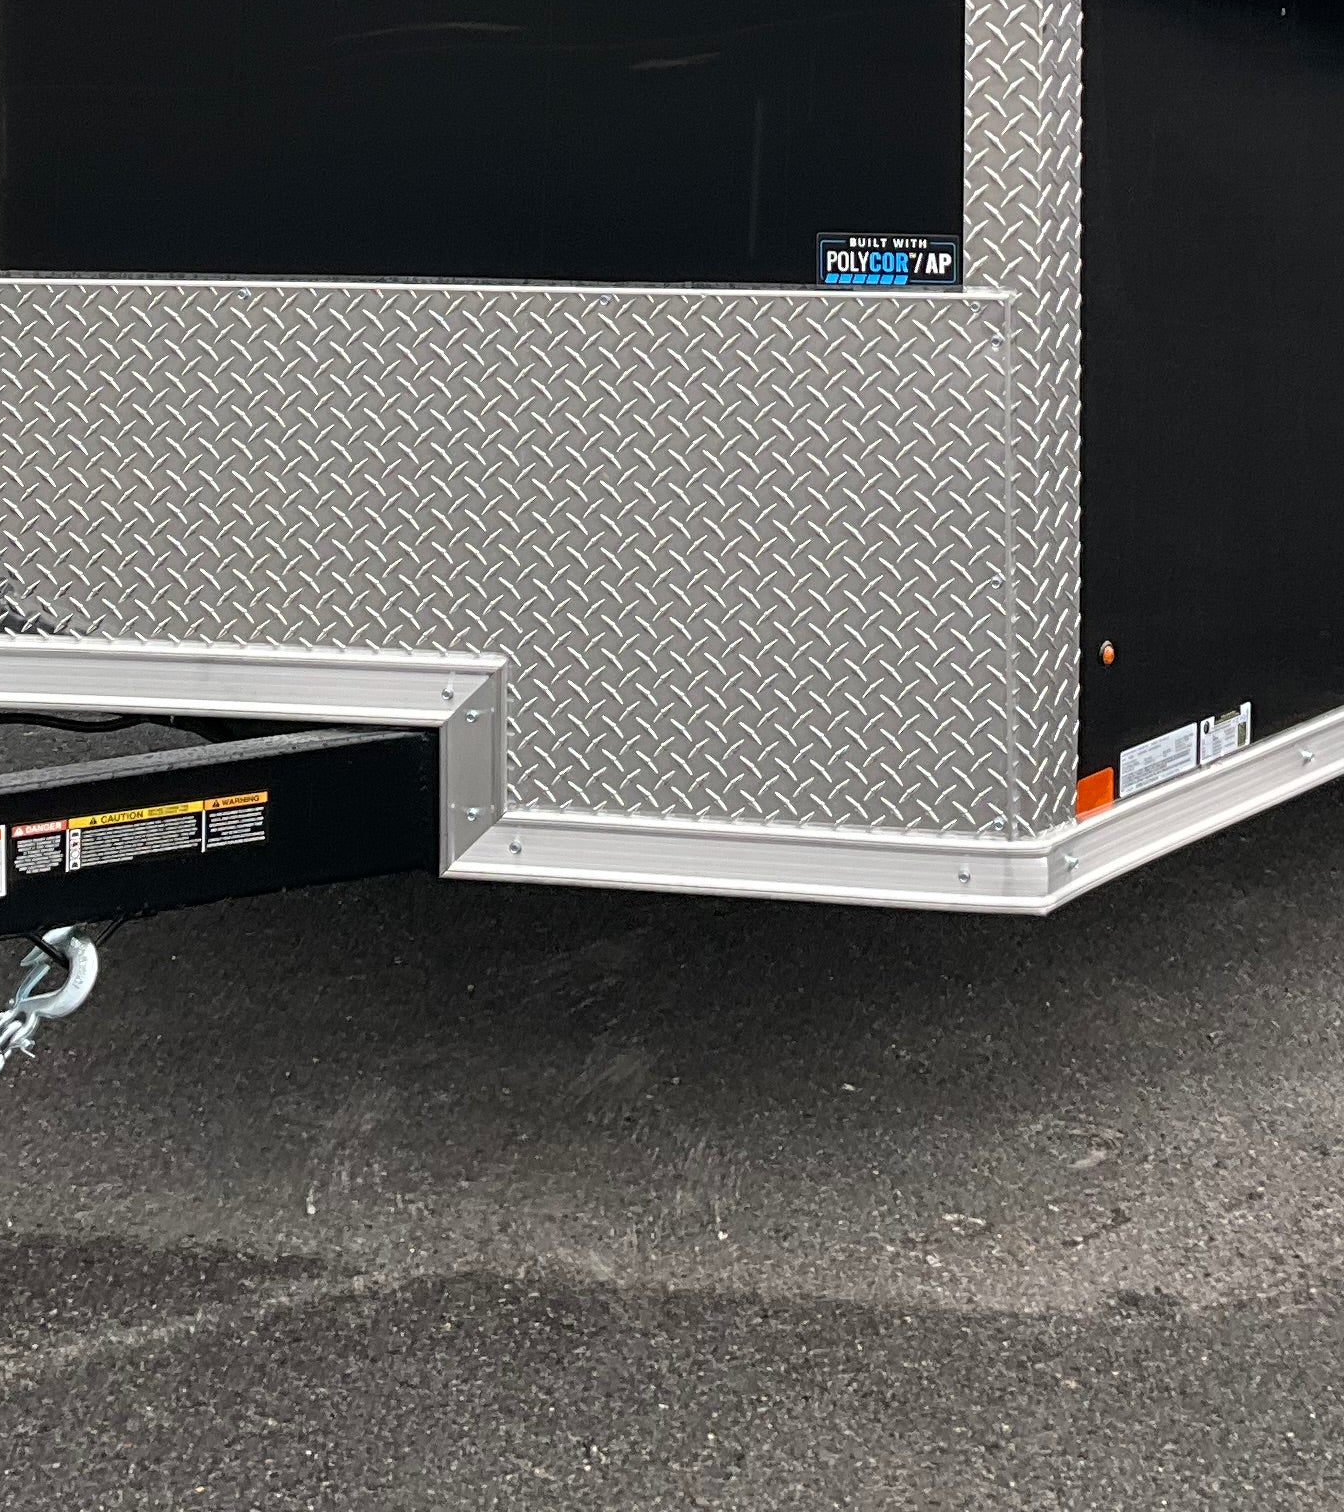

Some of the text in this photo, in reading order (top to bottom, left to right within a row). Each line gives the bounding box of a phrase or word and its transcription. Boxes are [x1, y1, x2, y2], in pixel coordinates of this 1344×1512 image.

[849, 238, 927, 249] BUILT WITH
[100, 810, 144, 824] CAUTION
[25, 821, 62, 834] DANGER
